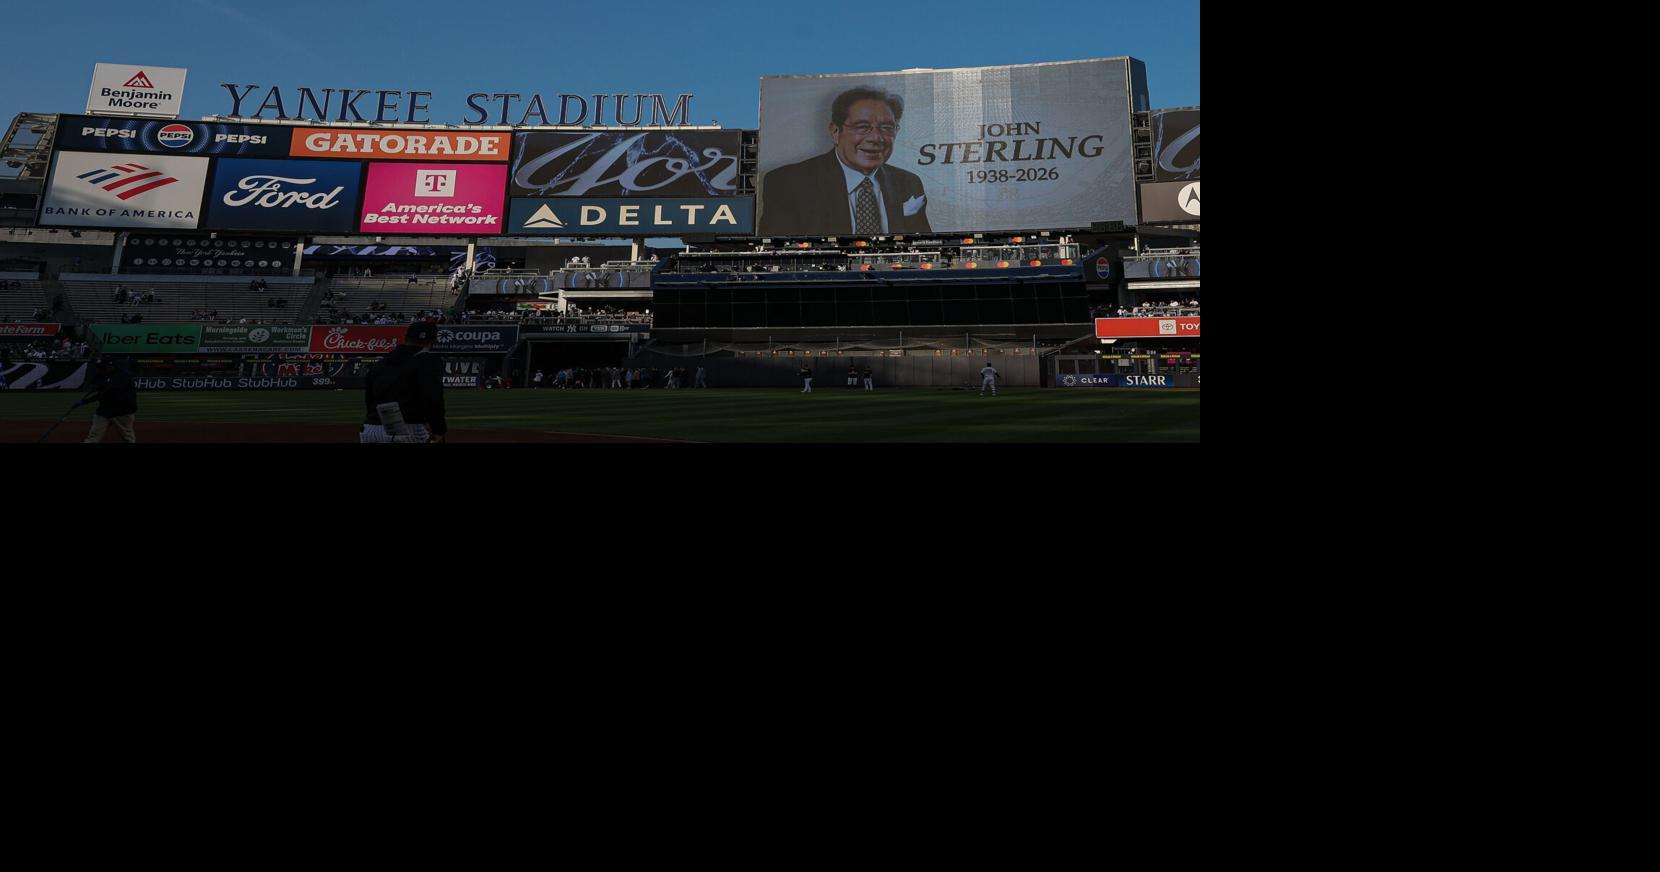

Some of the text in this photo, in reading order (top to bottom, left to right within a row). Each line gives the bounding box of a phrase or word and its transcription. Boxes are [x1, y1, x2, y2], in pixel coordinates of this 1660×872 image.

[101, 87, 172, 100] Benjamin
[108, 98, 158, 109] Moore
[221, 83, 693, 127] YANKEE STADIUM
[82, 127, 136, 138] PEPSI
[977, 121, 1041, 140] JOHN
[215, 133, 267, 144] PEPSI
[305, 133, 499, 155] GATORADE
[917, 135, 1104, 166] STERLING
[967, 167, 1059, 184] 1938-2026
[223, 175, 344, 209] Ford
[45, 207, 194, 219] BANK OF AMERICA
[381, 202, 483, 213] America's
[363, 213, 498, 225] Best Network
[580, 204, 737, 226] DELTA
[206, 326, 248, 335] Morningside
[146, 332, 195, 345] Eats
[455, 331, 500, 343] coupa
[172, 378, 232, 389] StubHub
[238, 378, 297, 388] StubHub
[312, 377, 330, 385] 399
[1126, 375, 1166, 386] STARR
